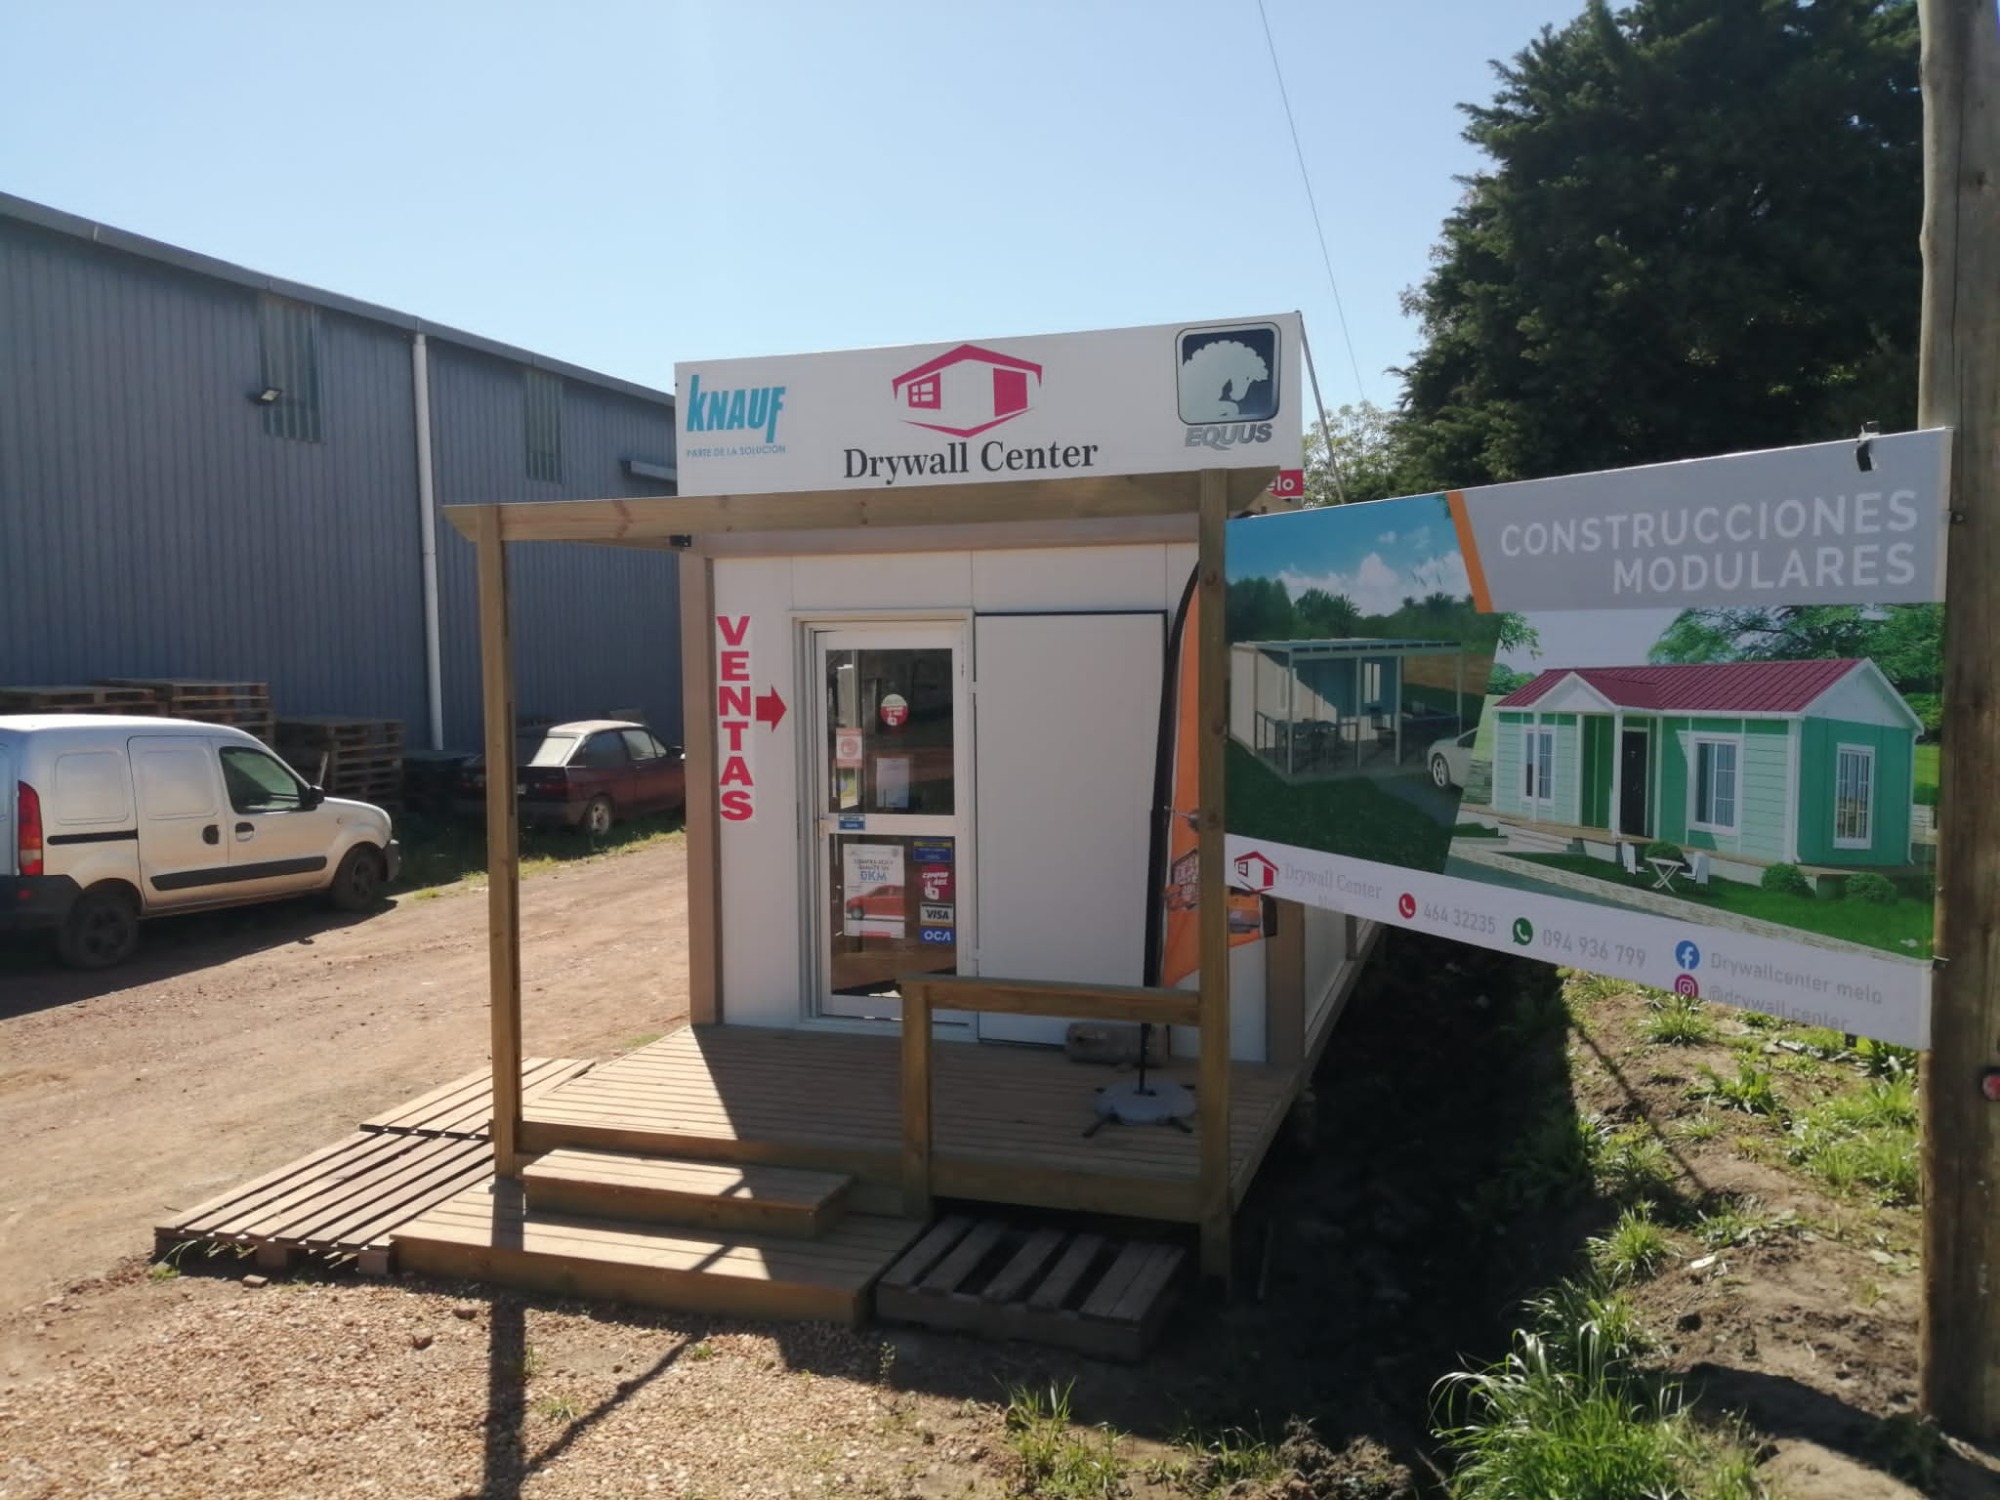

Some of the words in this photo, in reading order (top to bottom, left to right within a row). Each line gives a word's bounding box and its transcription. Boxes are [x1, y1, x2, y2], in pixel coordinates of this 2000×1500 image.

[687, 448, 712, 457] PARTE
[713, 447, 726, 456] DE
[727, 446, 738, 456] LA
[1184, 422, 1273, 450] EQUUS
[843, 442, 968, 485] Drywall
[980, 440, 1098, 471] Center
[1500, 489, 1919, 557] CONSTRUCCIONES
[1612, 542, 1917, 595] MODULARES
[716, 615, 754, 821] VENTAS
[1283, 864, 1334, 889] Drywall
[1336, 874, 1383, 899] Center
[926, 909, 949, 920] VISA
[1423, 902, 1450, 924] 464
[1453, 908, 1497, 936] 32235
[923, 930, 951, 941] OCA
[1542, 929, 1573, 955] 094
[1576, 935, 1610, 962] 936
[1614, 943, 1647, 969] 799
[1710, 952, 1830, 993] Drywallcenter
